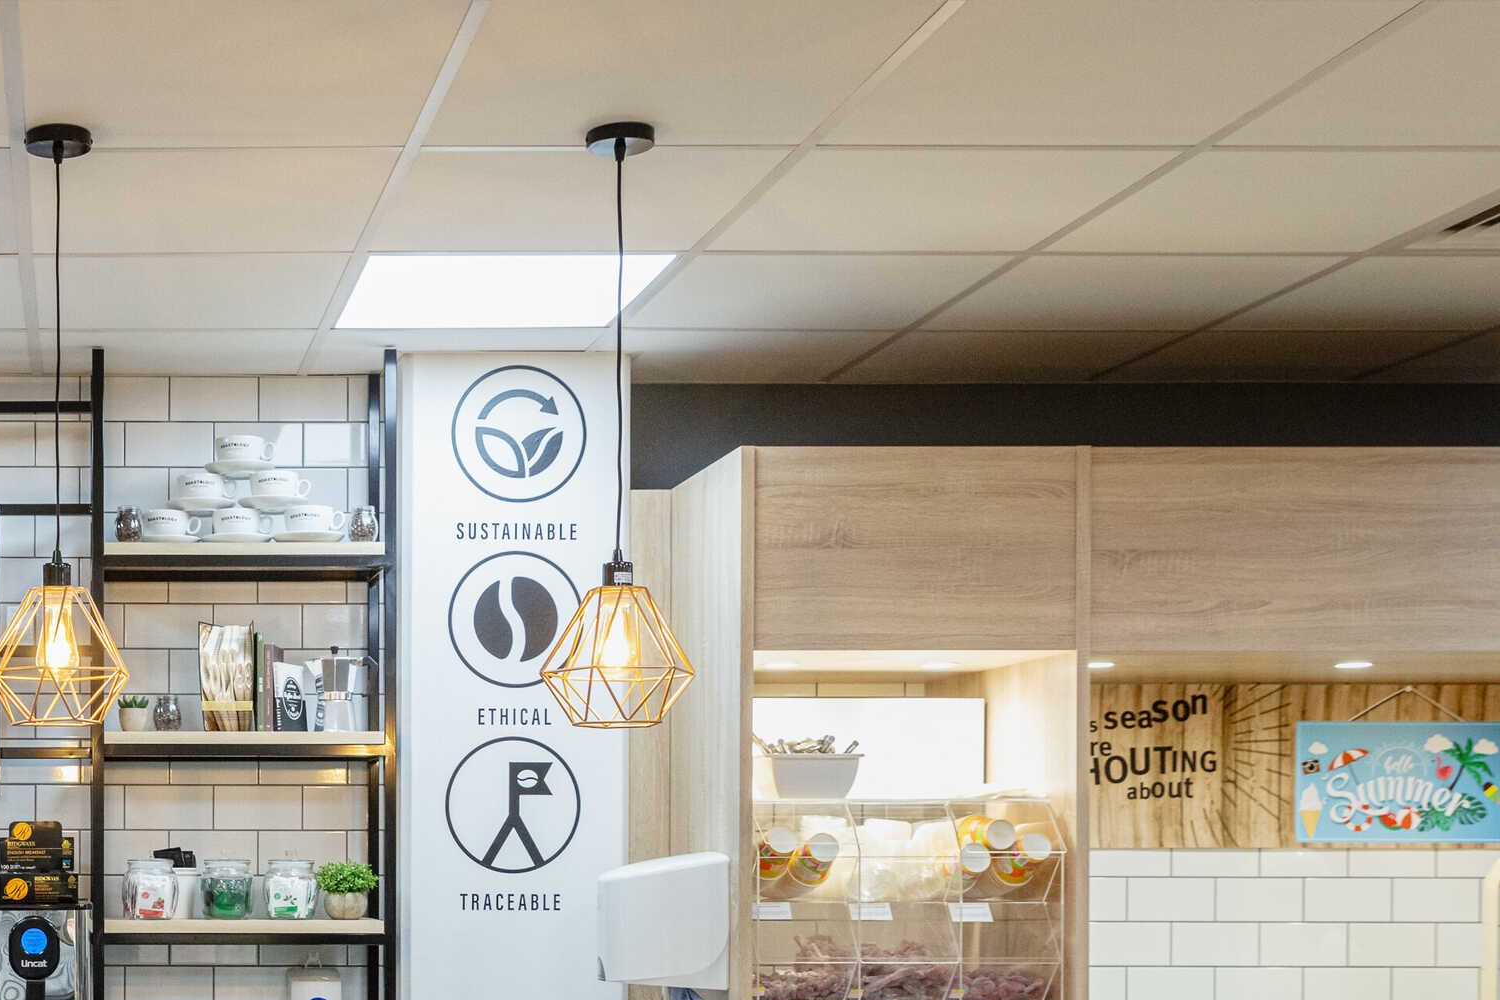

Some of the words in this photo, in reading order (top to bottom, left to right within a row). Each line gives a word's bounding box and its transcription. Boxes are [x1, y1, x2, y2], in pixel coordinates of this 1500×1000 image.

[456, 522, 578, 541] SUSTAINABLE
[478, 708, 552, 726] ETHICAL
[1104, 694, 1208, 730] season
[1090, 741, 1112, 756] re
[1127, 777, 1194, 800] about
[1326, 772, 1471, 824] Summer
[460, 893, 562, 912] TRACEABLE
